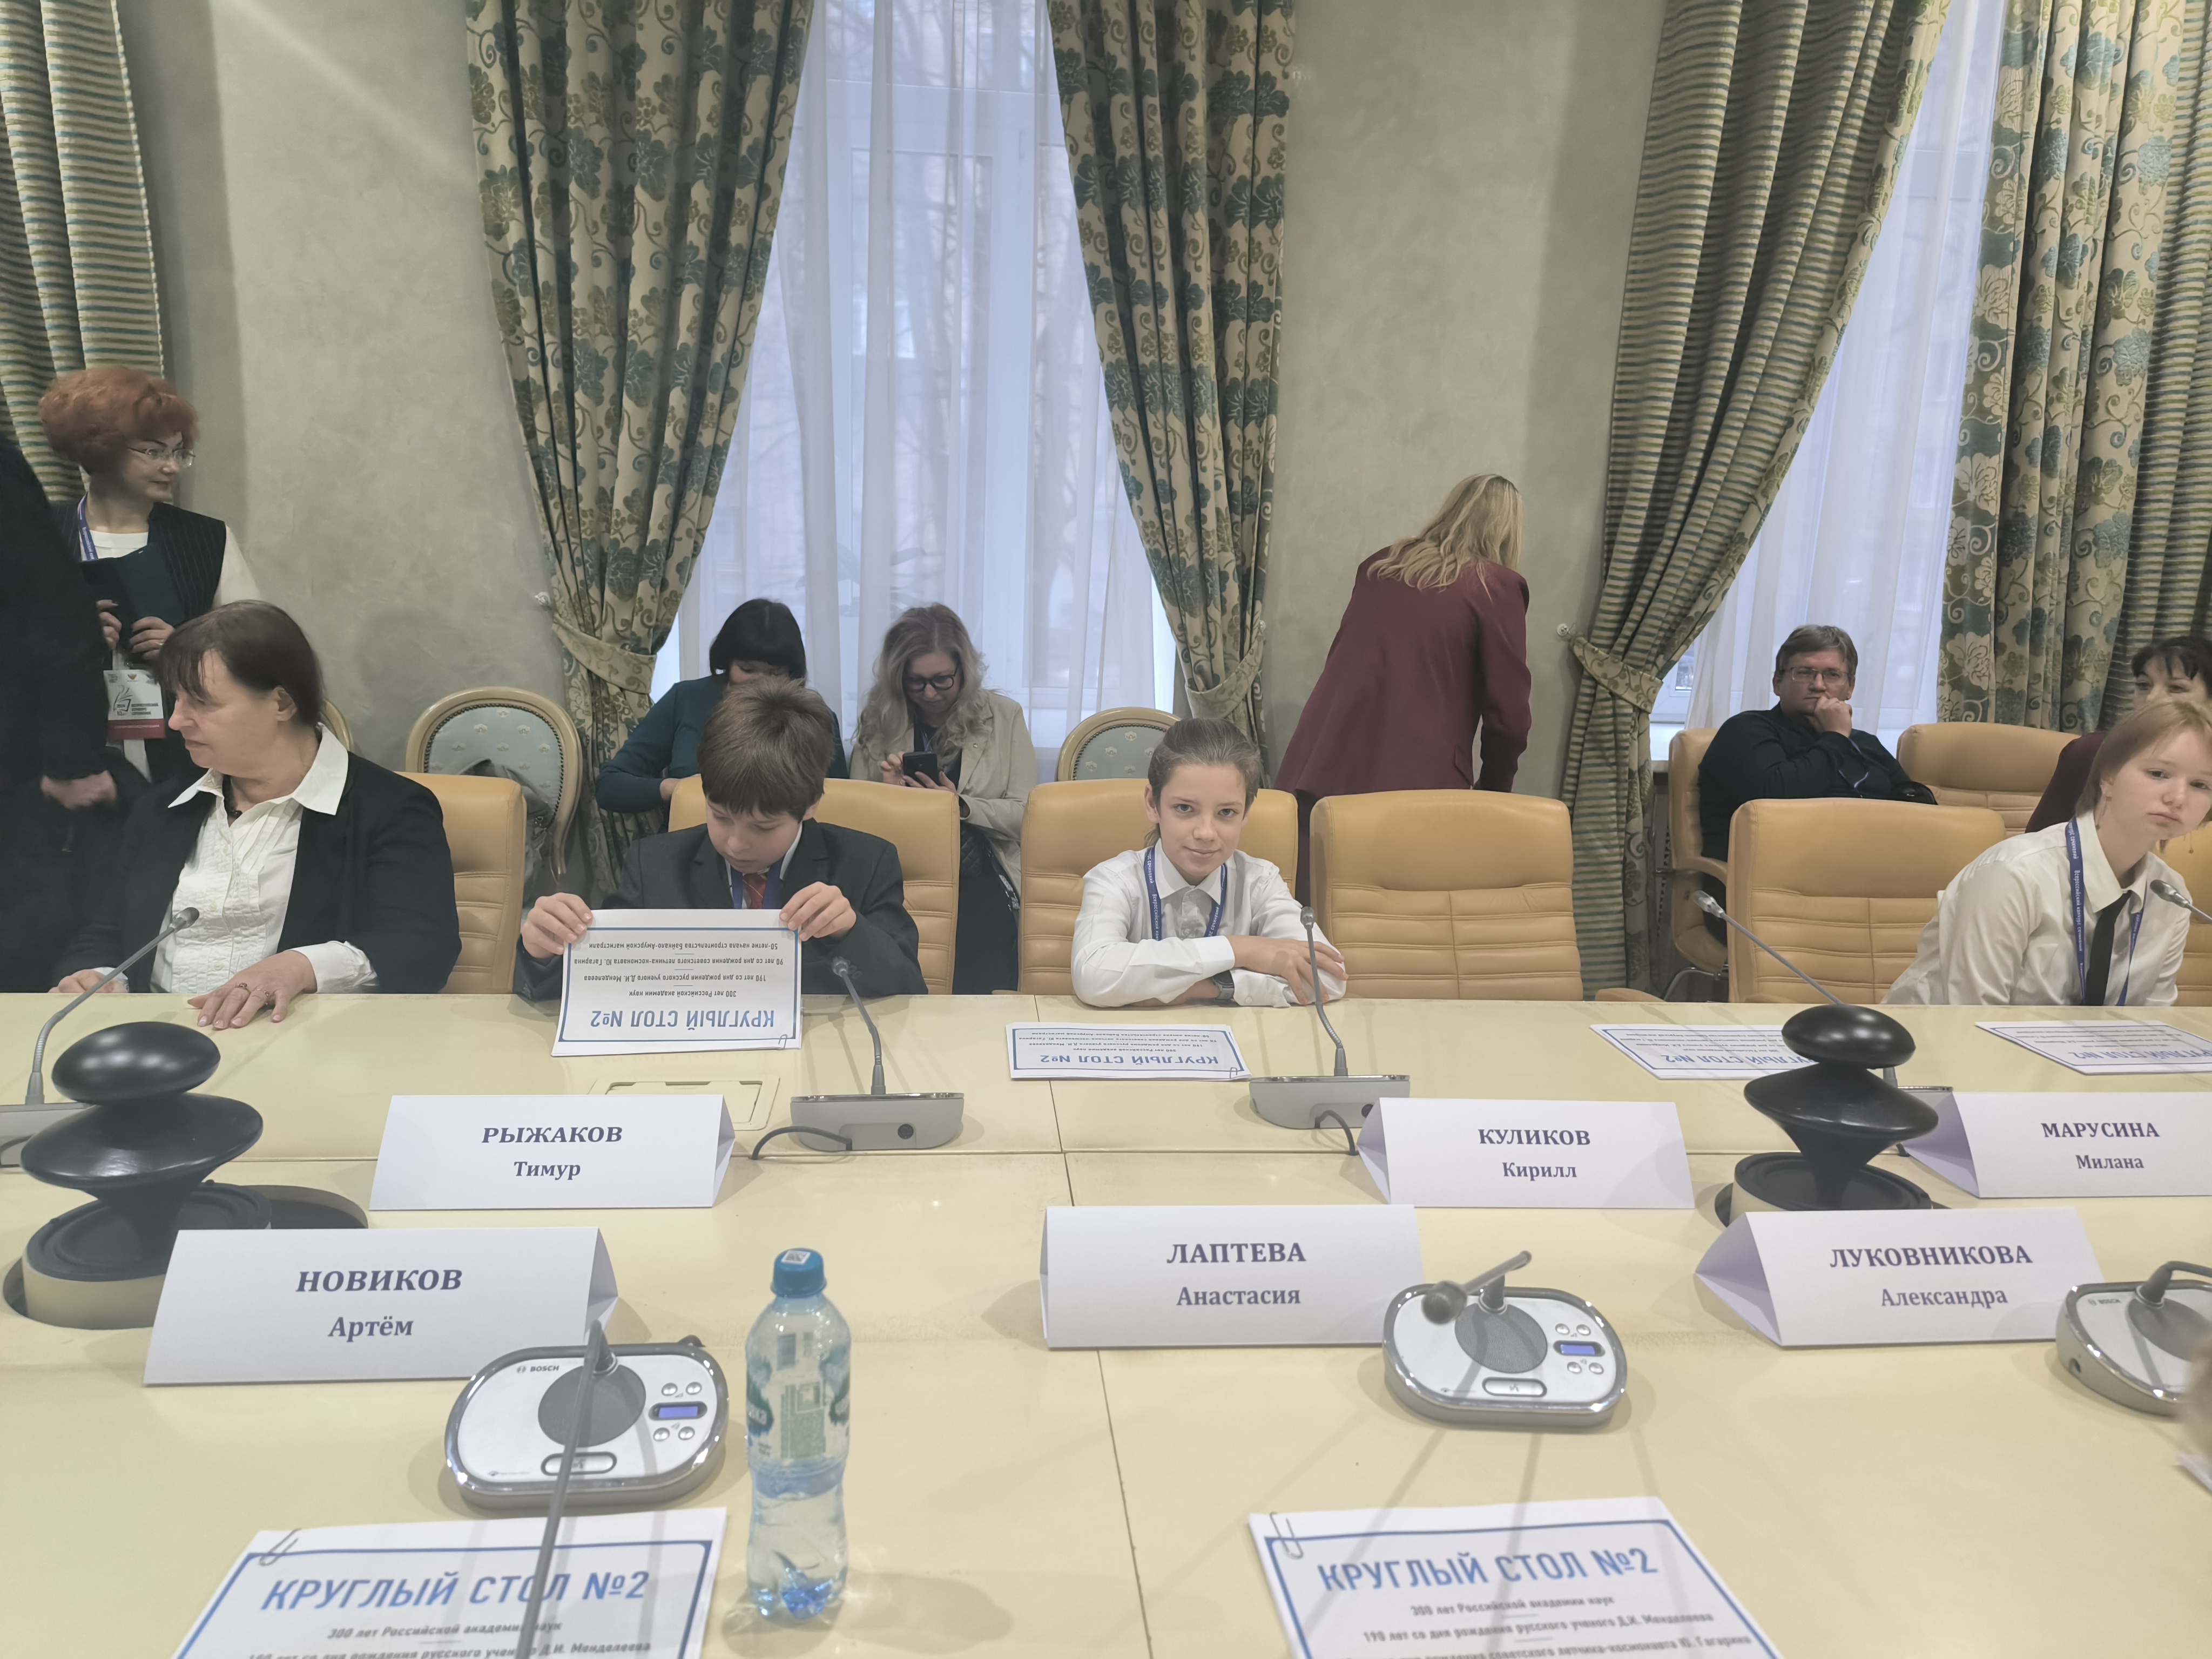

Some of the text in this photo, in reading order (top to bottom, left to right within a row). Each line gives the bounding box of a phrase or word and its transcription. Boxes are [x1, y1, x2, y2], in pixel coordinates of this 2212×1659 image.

[591, 1010, 774, 1030] КРУГЛЫЙ СТОЛ №2
[1132, 1056, 1218, 1064] КРУГЛЫЙ
[1697, 1055, 1743, 1063] СТОЛ
[1745, 1056, 1815, 1064] УГЛЫЙ
[482, 1127, 622, 1143] РЫЖАКОВ
[1478, 1129, 1590, 1145] КУЛИКОВ
[2041, 1123, 2160, 1137] МАРУСИНА
[514, 1162, 580, 1180] Тимур
[2076, 1155, 2144, 1169] Милана
[1502, 1163, 1577, 1181] Кирилл
[1167, 1243, 1306, 1263] ЛАПТЕВА
[1830, 1246, 2033, 1267] ЛУКОВНИКОВА
[296, 1270, 462, 1292] НОВИКОВ
[1177, 1287, 1300, 1305] Анастасия
[1882, 1289, 2008, 1309] Александра
[328, 1316, 413, 1342] Артём
[1317, 1548, 1658, 1590] КРУГЛЫЙ СТОЛ №2
[261, 1570, 650, 1610] КРУГЛЫЙ СТОЛ №2
[1457, 1600, 1526, 1613] Российской
[327, 1627, 354, 1639] 300
[355, 1629, 379, 1638] лет
[381, 1624, 460, 1637] Российской
[463, 1624, 523, 1634] академи
